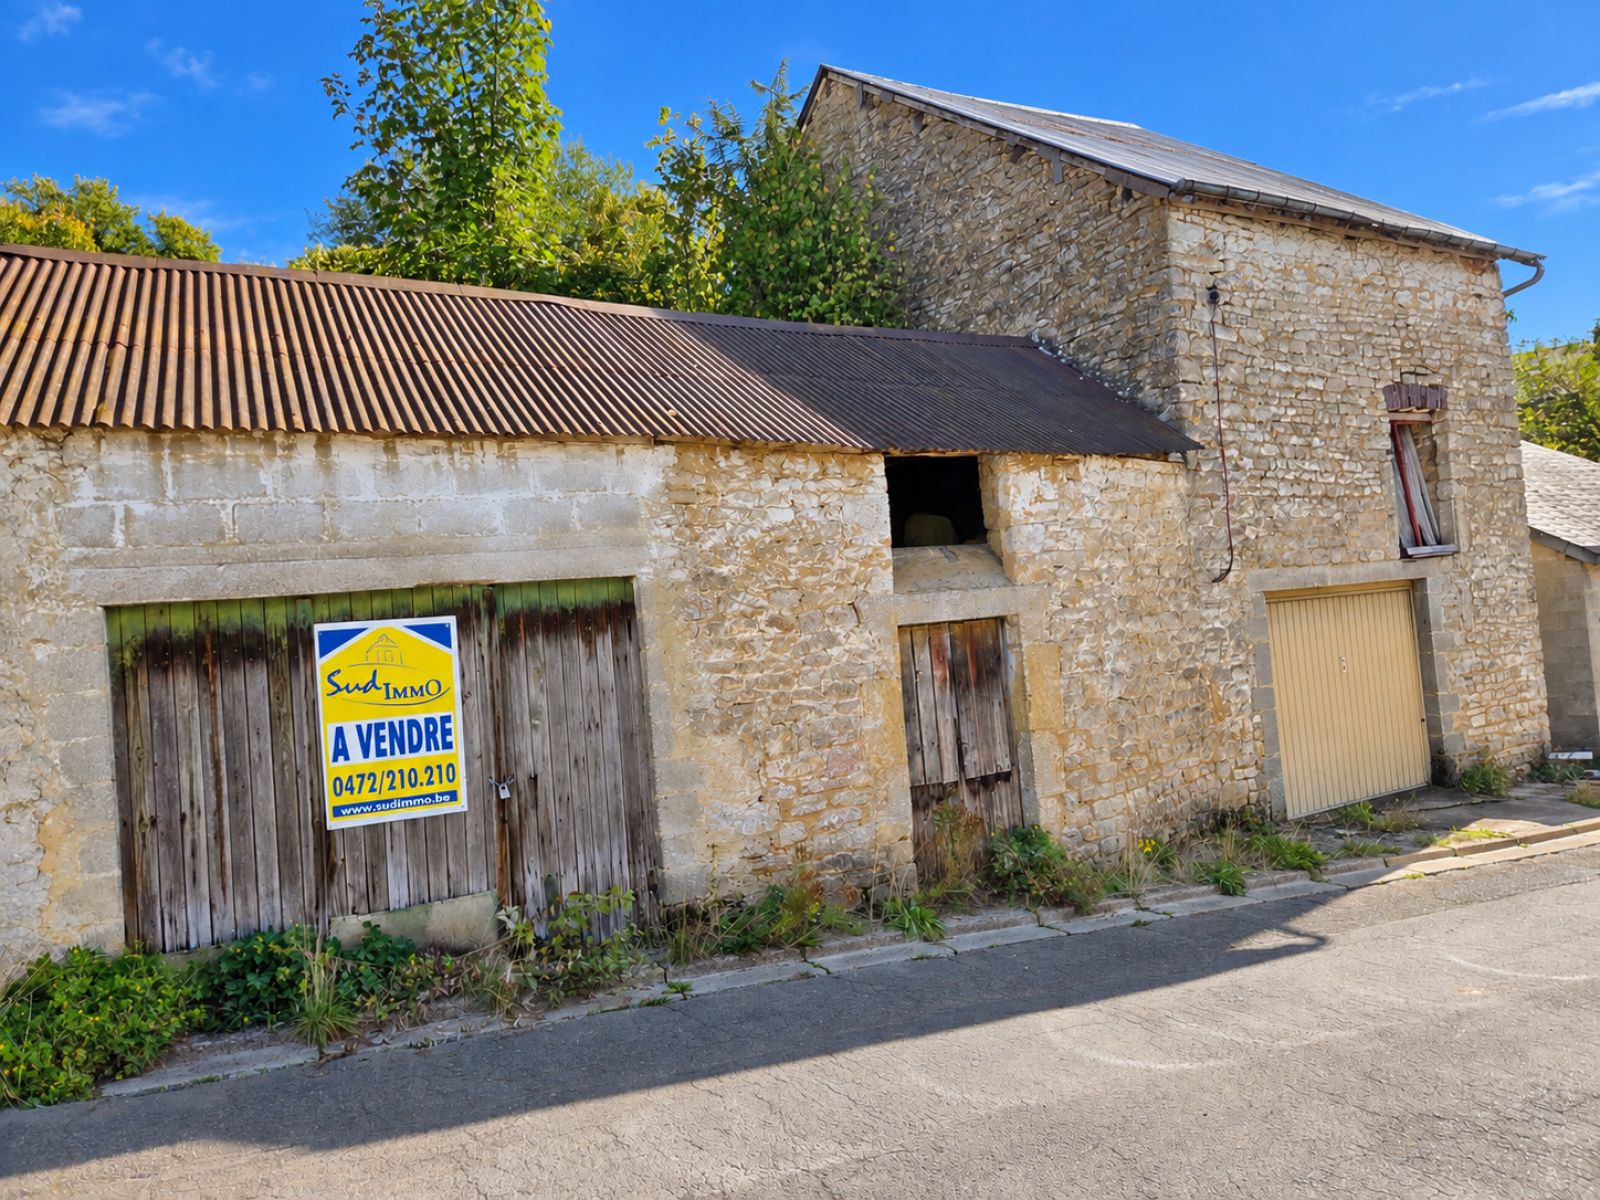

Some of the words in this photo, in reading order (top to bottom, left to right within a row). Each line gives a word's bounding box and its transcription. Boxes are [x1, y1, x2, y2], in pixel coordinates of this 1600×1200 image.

[326, 669, 382, 696] Sud
[331, 726, 350, 763] A
[356, 714, 454, 759] VENDRE
[333, 763, 456, 797] 0472/210.210
[340, 793, 451, 816] www.sudimmo.be
